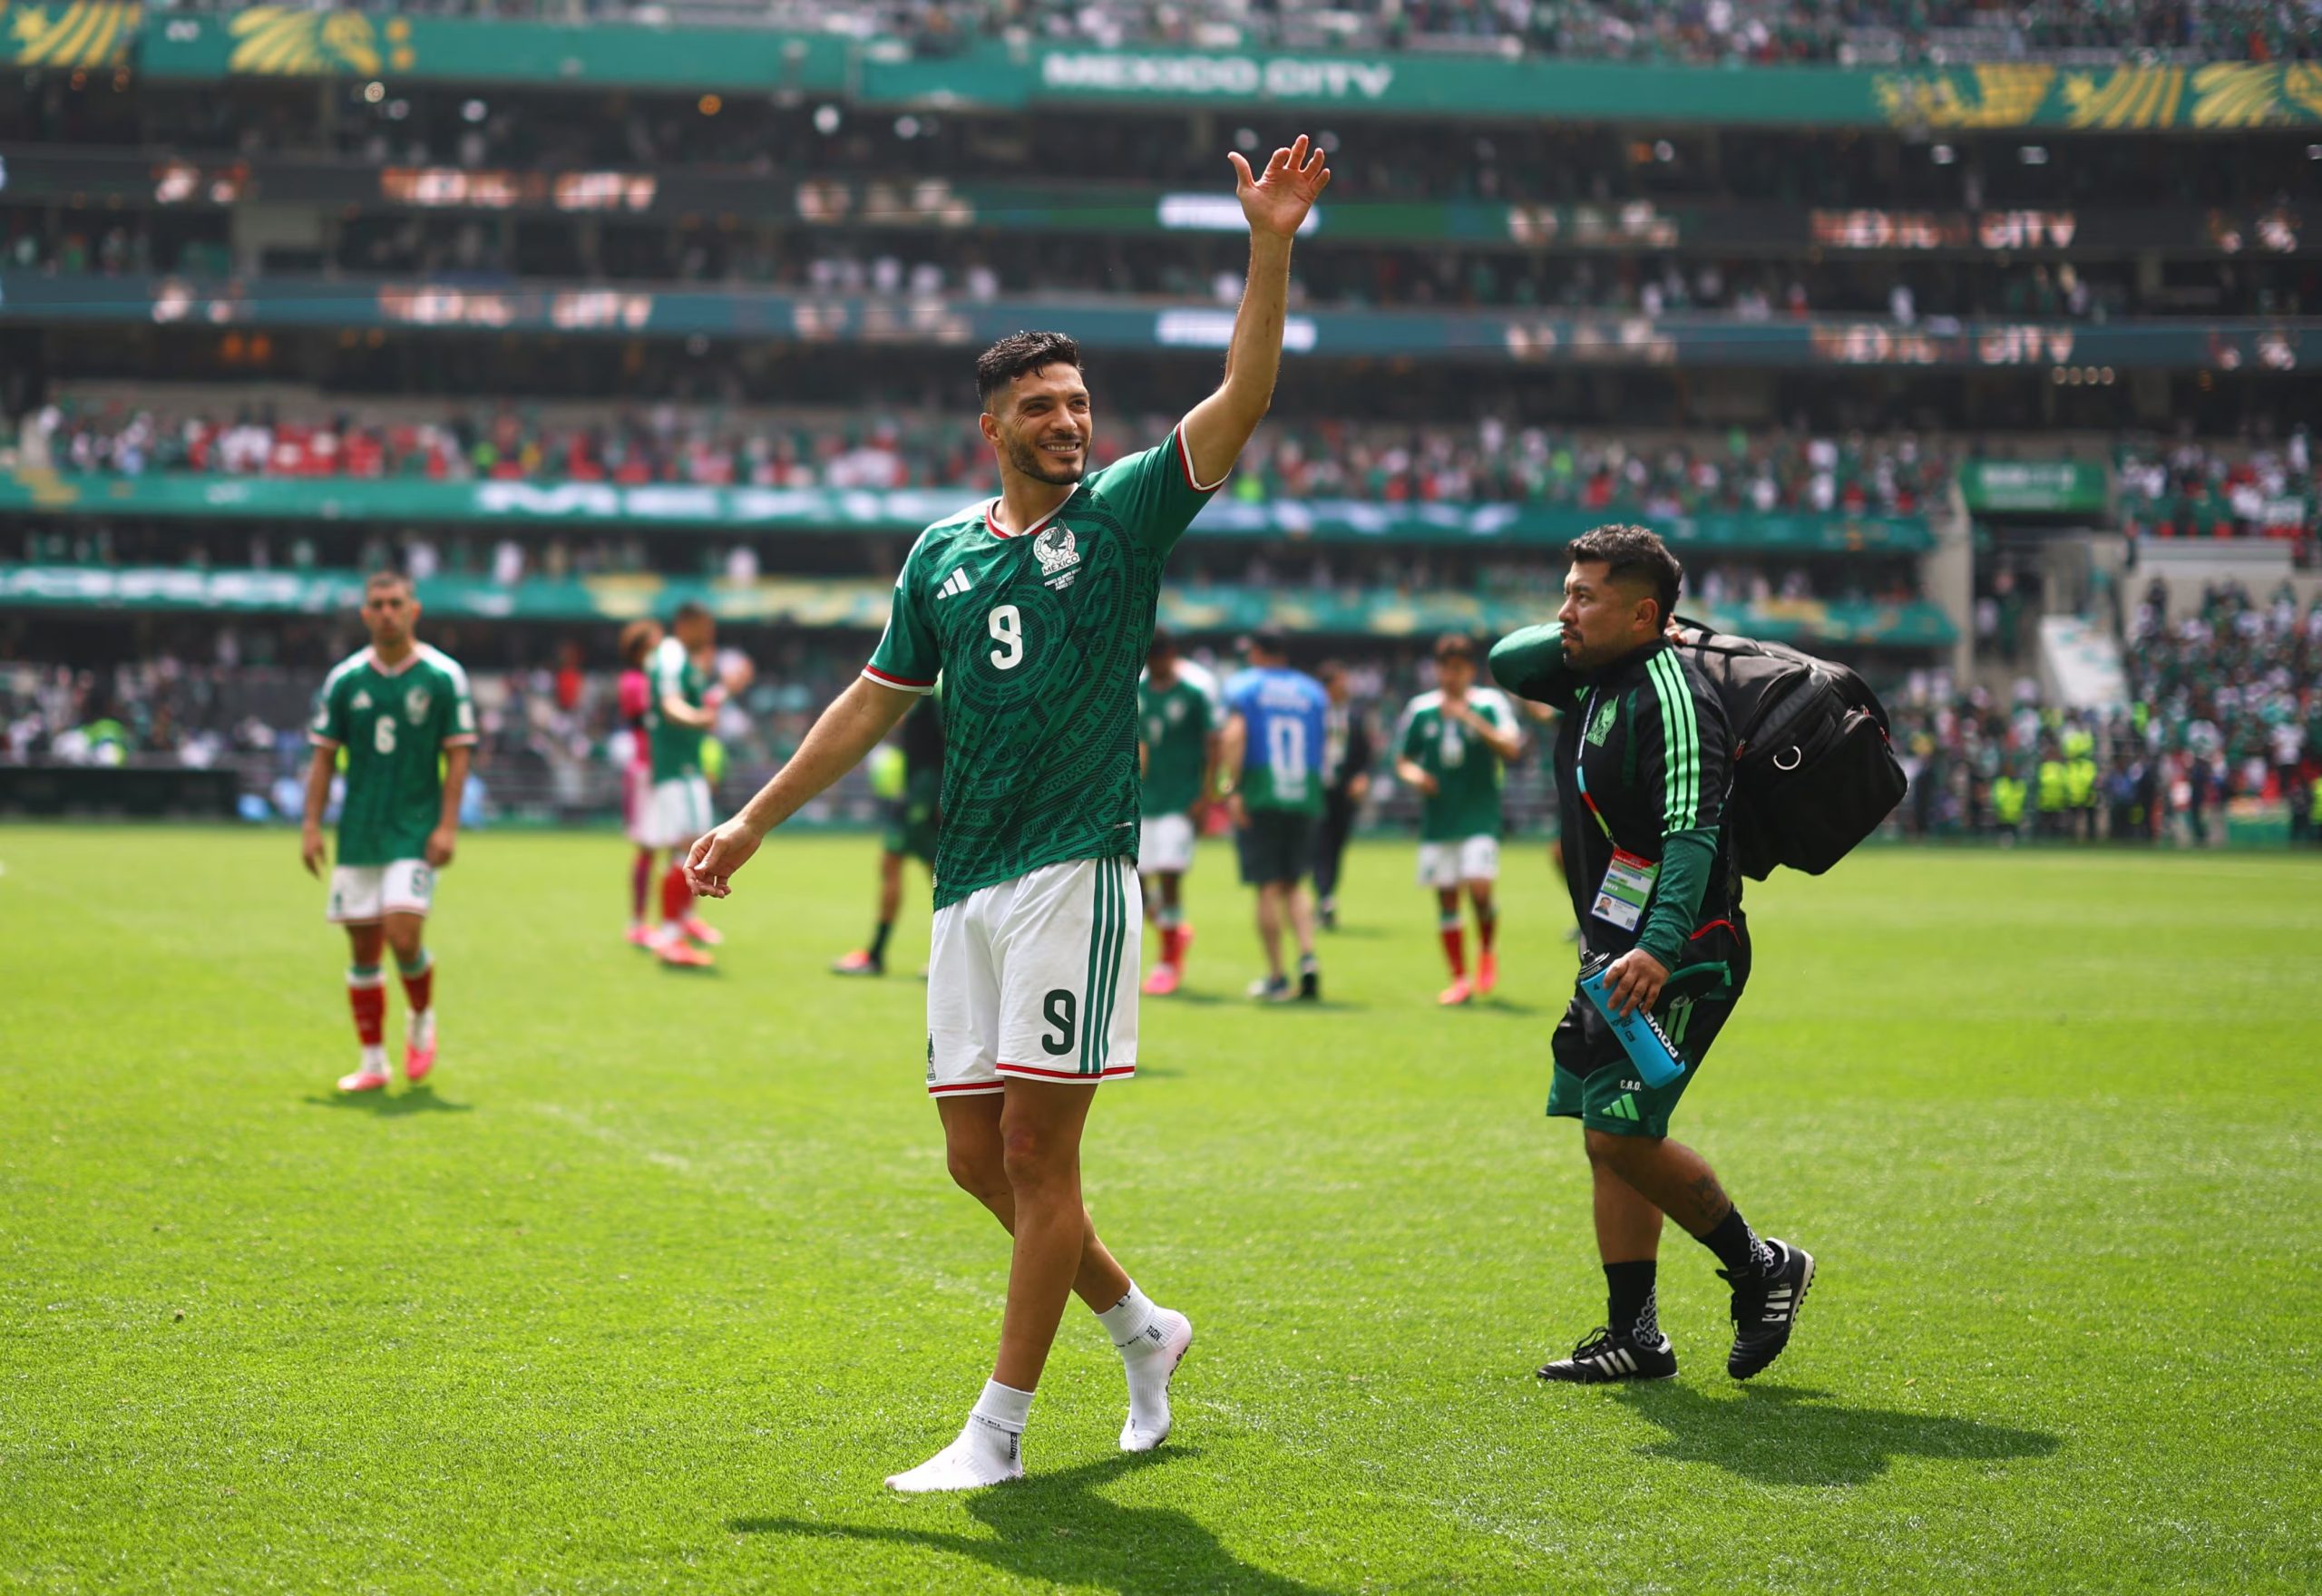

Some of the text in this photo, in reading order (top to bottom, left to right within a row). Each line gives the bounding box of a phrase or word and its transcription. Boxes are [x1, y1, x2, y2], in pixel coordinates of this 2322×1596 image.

[1043, 52, 1394, 98] MEXICO CITY
[988, 605, 1024, 670] 9
[374, 715, 397, 754] 6
[1042, 989, 1077, 1056] 9
[1639, 1000, 1679, 1059] POWE
